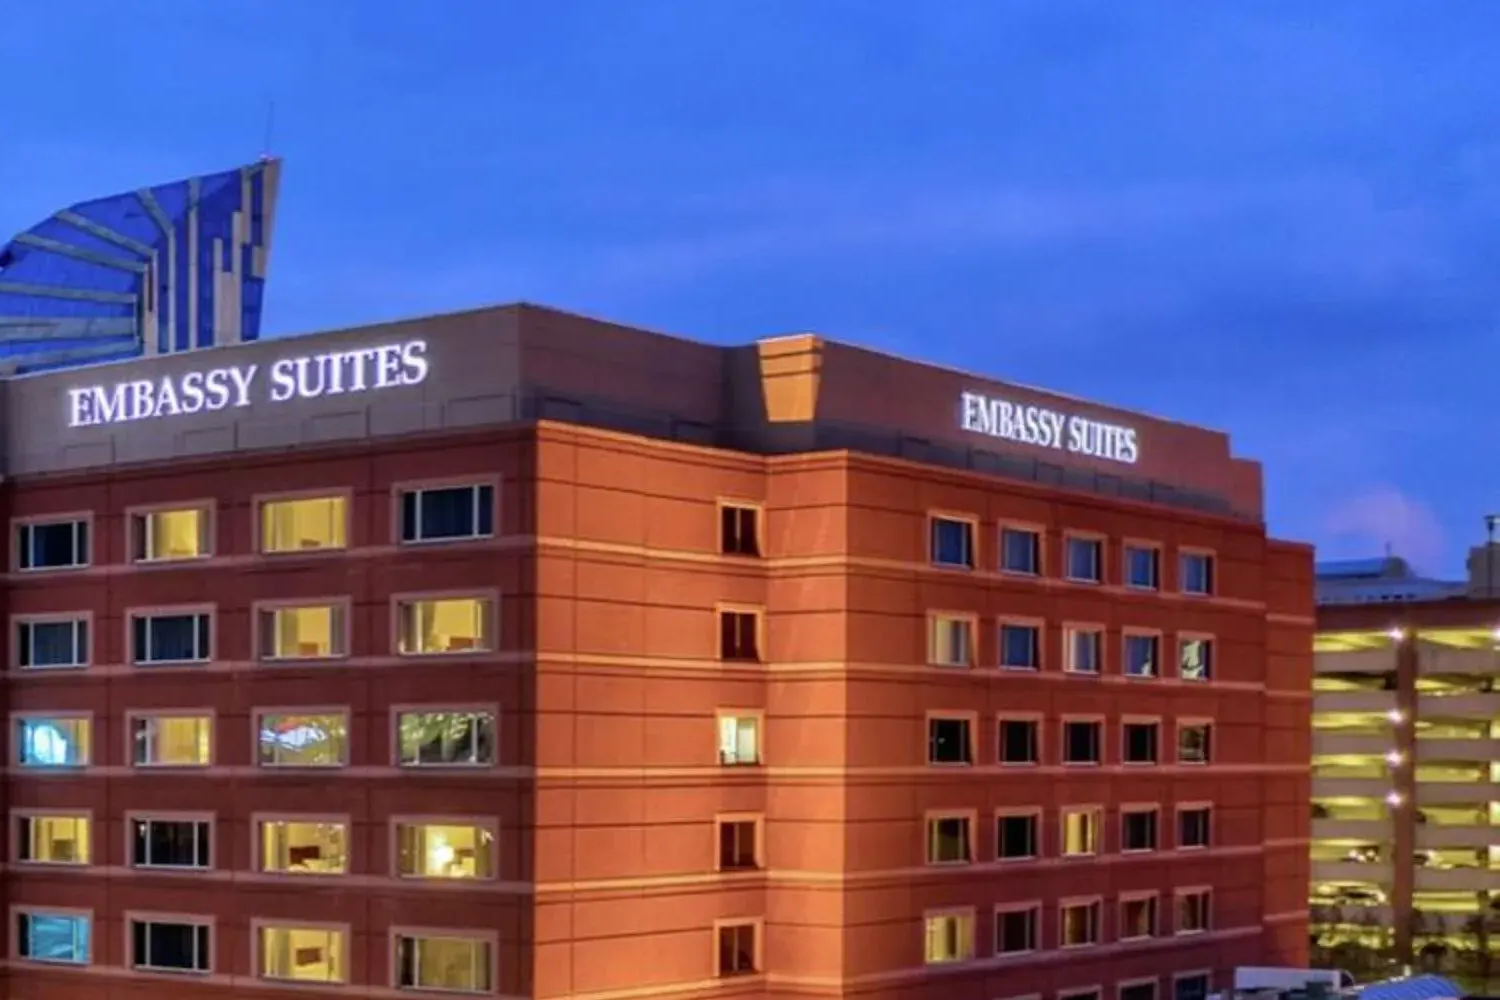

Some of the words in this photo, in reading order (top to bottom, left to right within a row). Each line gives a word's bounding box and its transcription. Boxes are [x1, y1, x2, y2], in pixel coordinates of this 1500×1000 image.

[68, 365, 257, 427] EMBASSY
[271, 341, 428, 400] SUITES
[961, 392, 1065, 448] EMBASSY
[1069, 416, 1138, 463] SUITES
